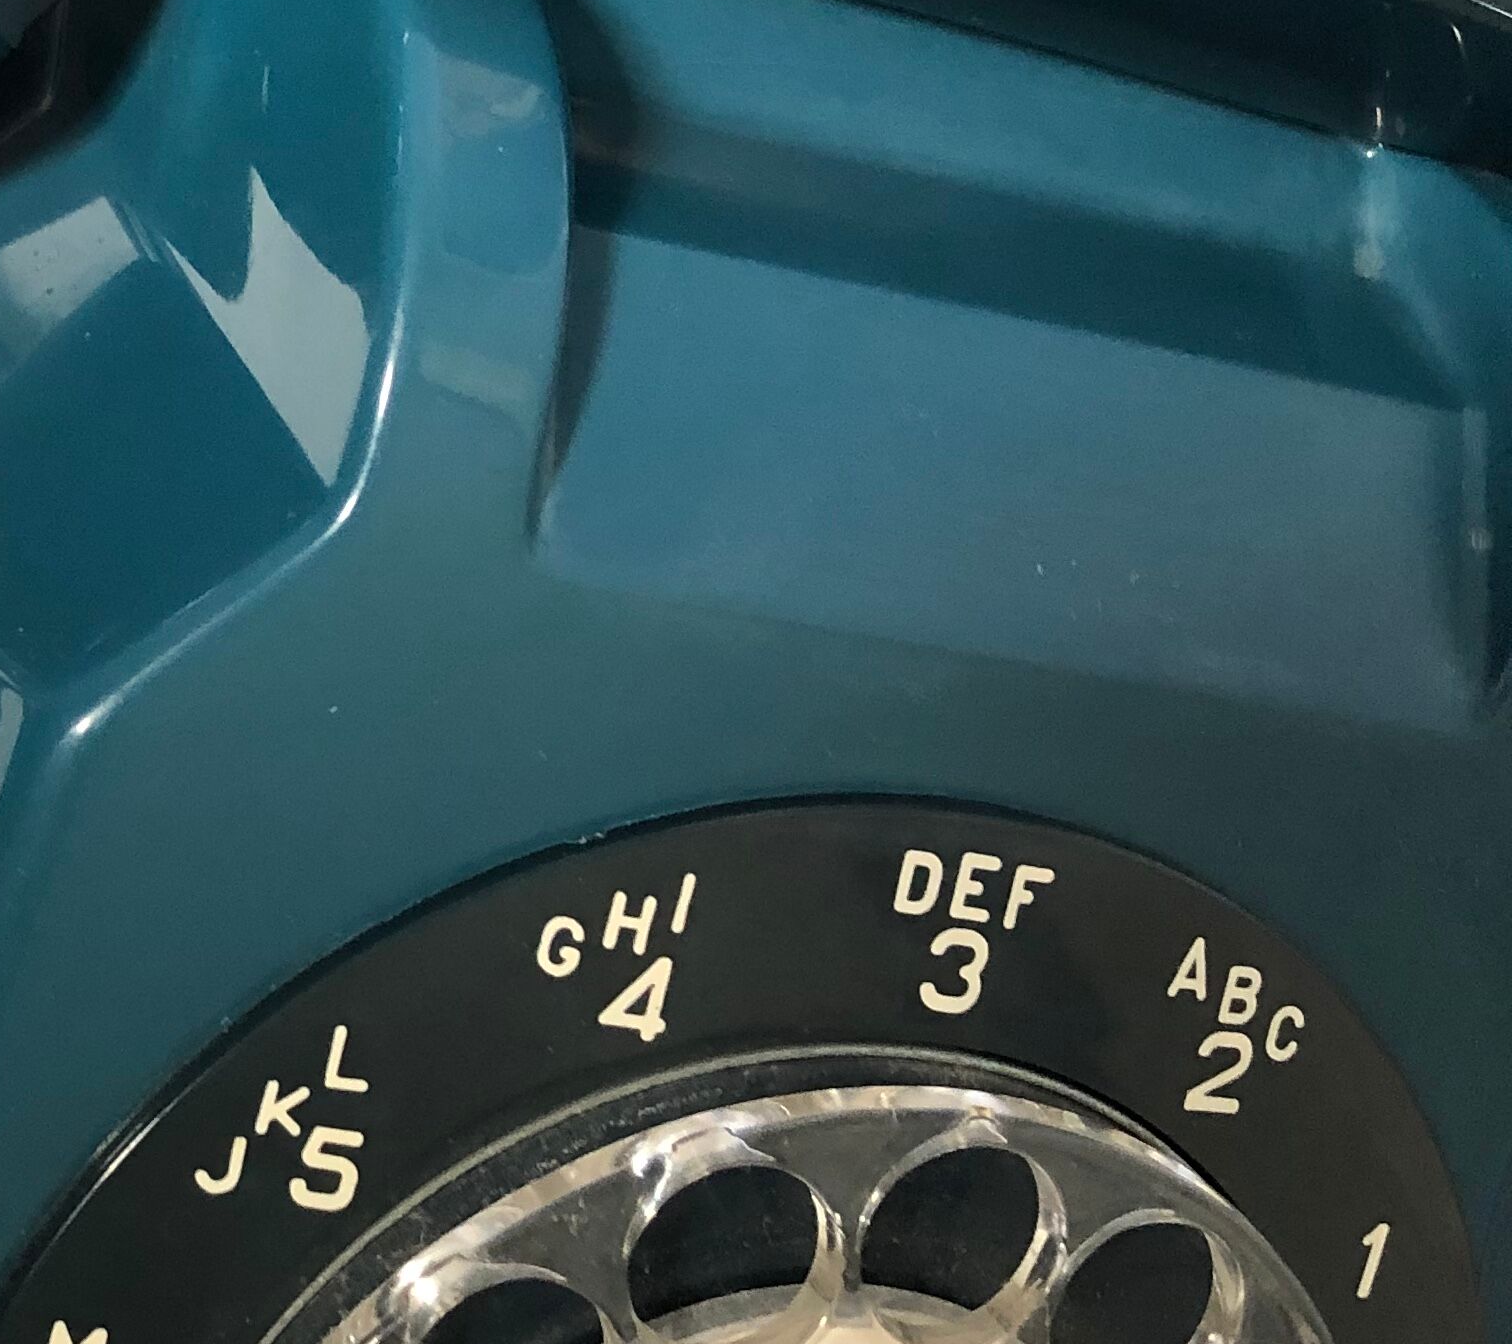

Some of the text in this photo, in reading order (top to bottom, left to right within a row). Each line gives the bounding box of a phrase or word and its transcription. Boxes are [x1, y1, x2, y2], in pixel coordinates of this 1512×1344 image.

[535, 871, 698, 979] GHI
[893, 848, 1057, 931] DEF
[596, 955, 675, 1044] 4
[919, 926, 991, 1015] 3
[1165, 935, 1306, 1063] ABC
[1183, 1029, 1255, 1116] 2
[287, 1124, 366, 1214] 5
[1355, 1221, 1392, 1300] 1
